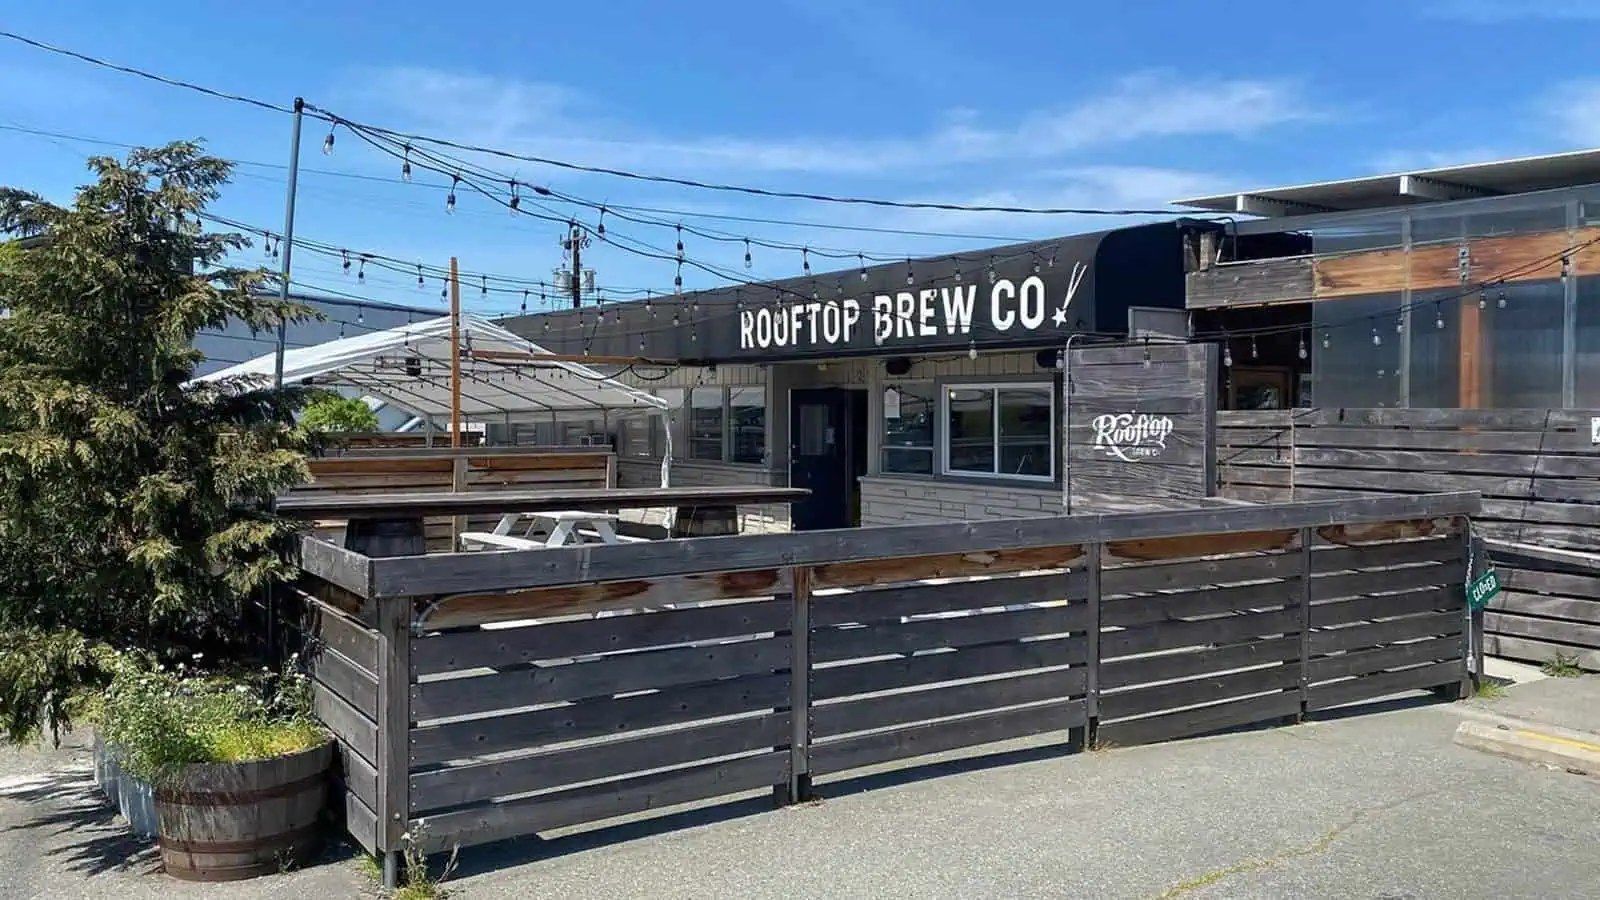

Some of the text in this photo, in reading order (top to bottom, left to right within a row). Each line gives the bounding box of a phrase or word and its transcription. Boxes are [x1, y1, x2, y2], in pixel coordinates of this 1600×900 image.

[741, 276, 1045, 349] ROOFTOP BREW CO
[1092, 413, 1173, 462] Rooftop
[1472, 575, 1496, 602] CLOSED
